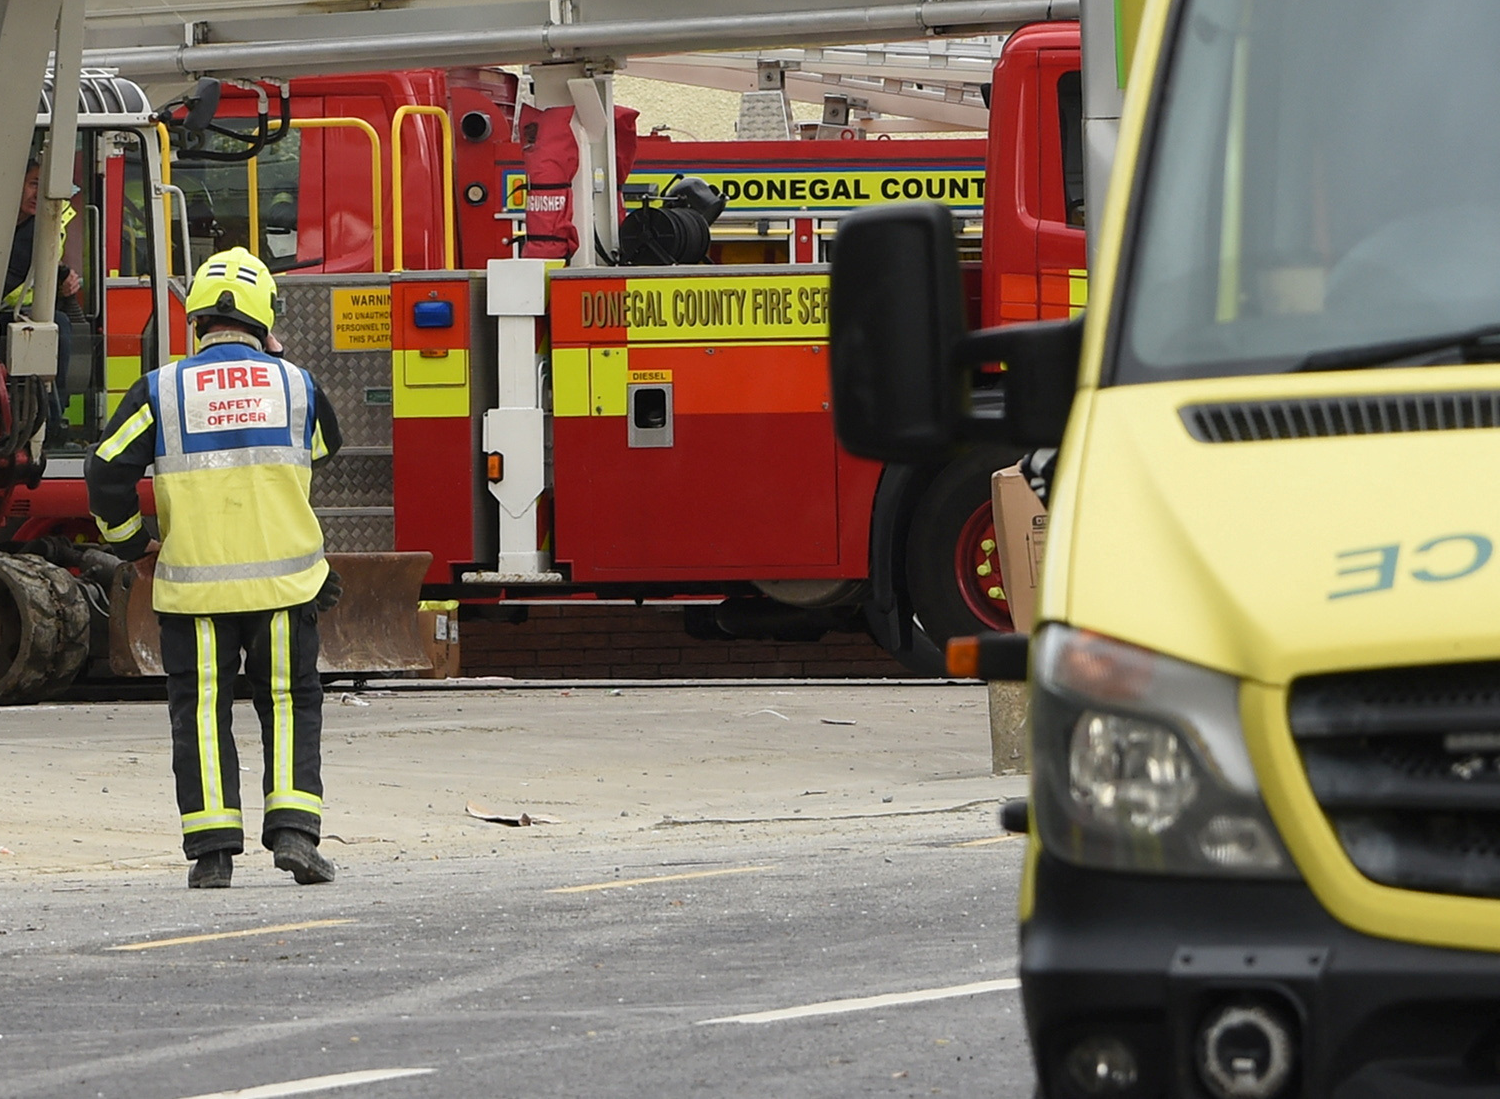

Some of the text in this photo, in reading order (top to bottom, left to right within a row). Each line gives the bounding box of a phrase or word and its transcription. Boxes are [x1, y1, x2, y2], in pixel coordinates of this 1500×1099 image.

[721, 178, 871, 201] DONEGAL
[581, 289, 667, 328] DONEGAL
[672, 288, 746, 327] COUNTY
[751, 287, 792, 326] FIRE
[342, 312, 353, 320] NO
[336, 323, 390, 332] PERSONNEL TO
[349, 335, 365, 343] THIS
[196, 366, 271, 392] FIRE
[632, 372, 666, 381] DIESEL
[208, 398, 262, 412] SAFETY
[207, 411, 267, 426] OFFICER
